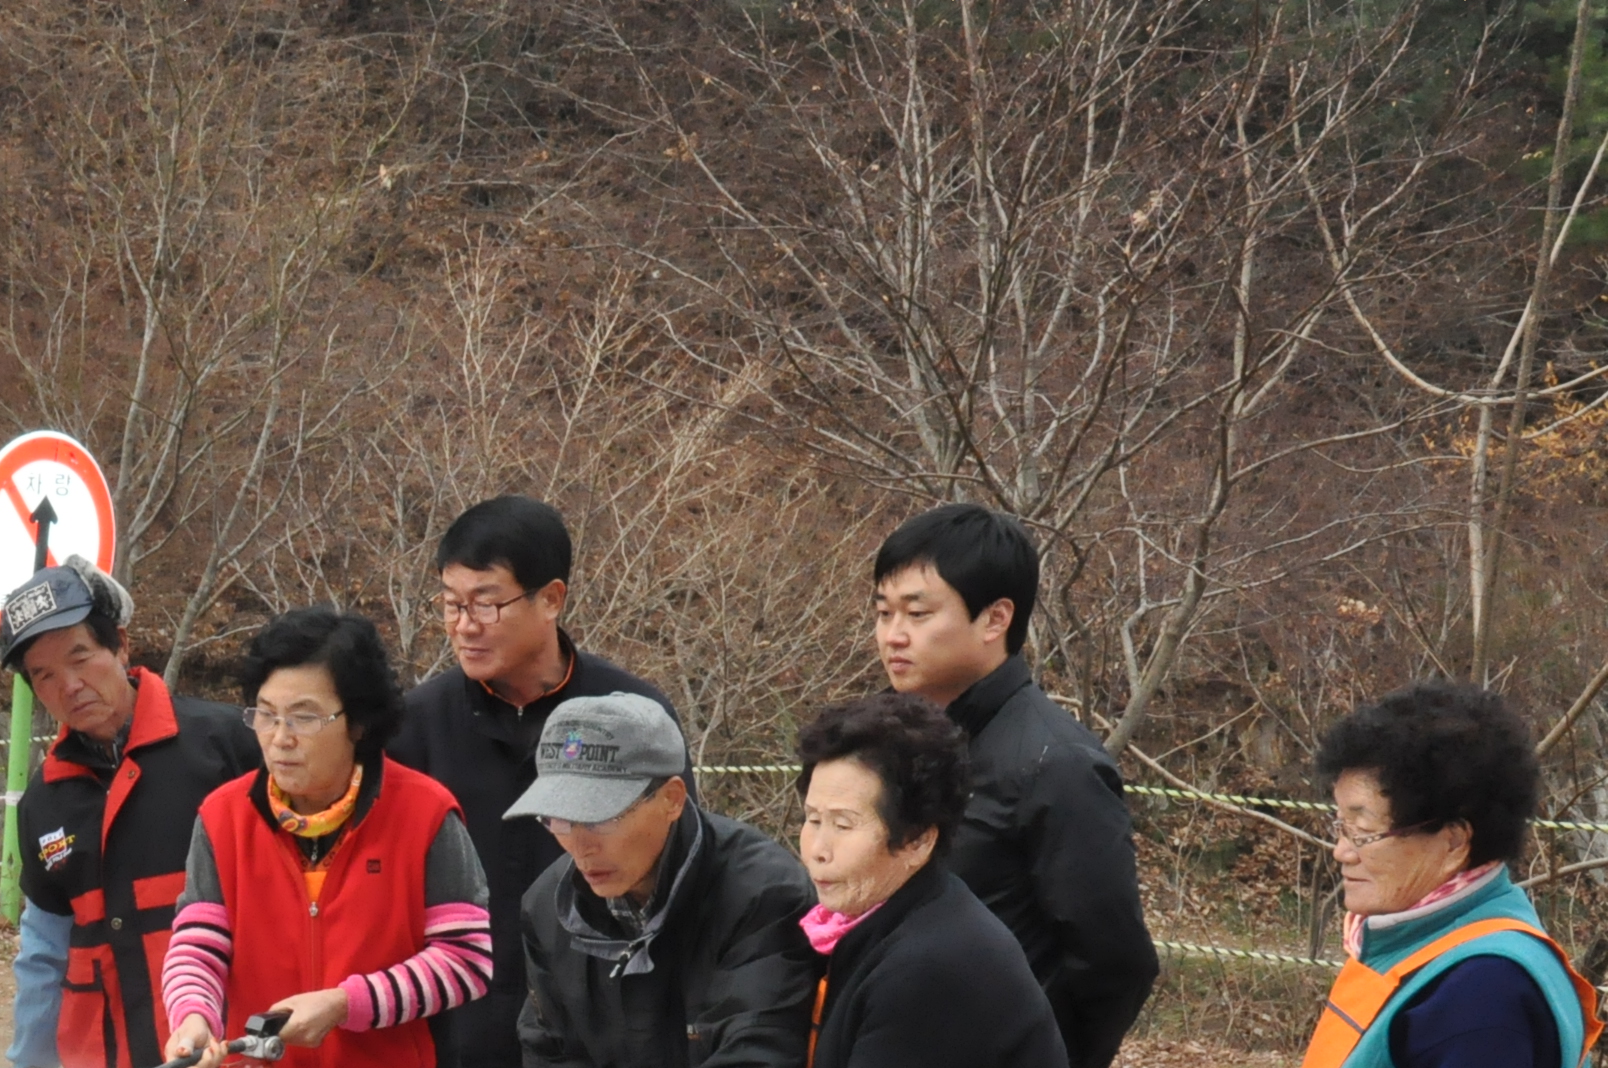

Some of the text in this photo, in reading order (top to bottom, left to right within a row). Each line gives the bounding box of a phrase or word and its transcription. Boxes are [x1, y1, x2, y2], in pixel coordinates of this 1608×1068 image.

[540, 742, 620, 763] WEST POINT
[38, 834, 76, 861] SPORT
